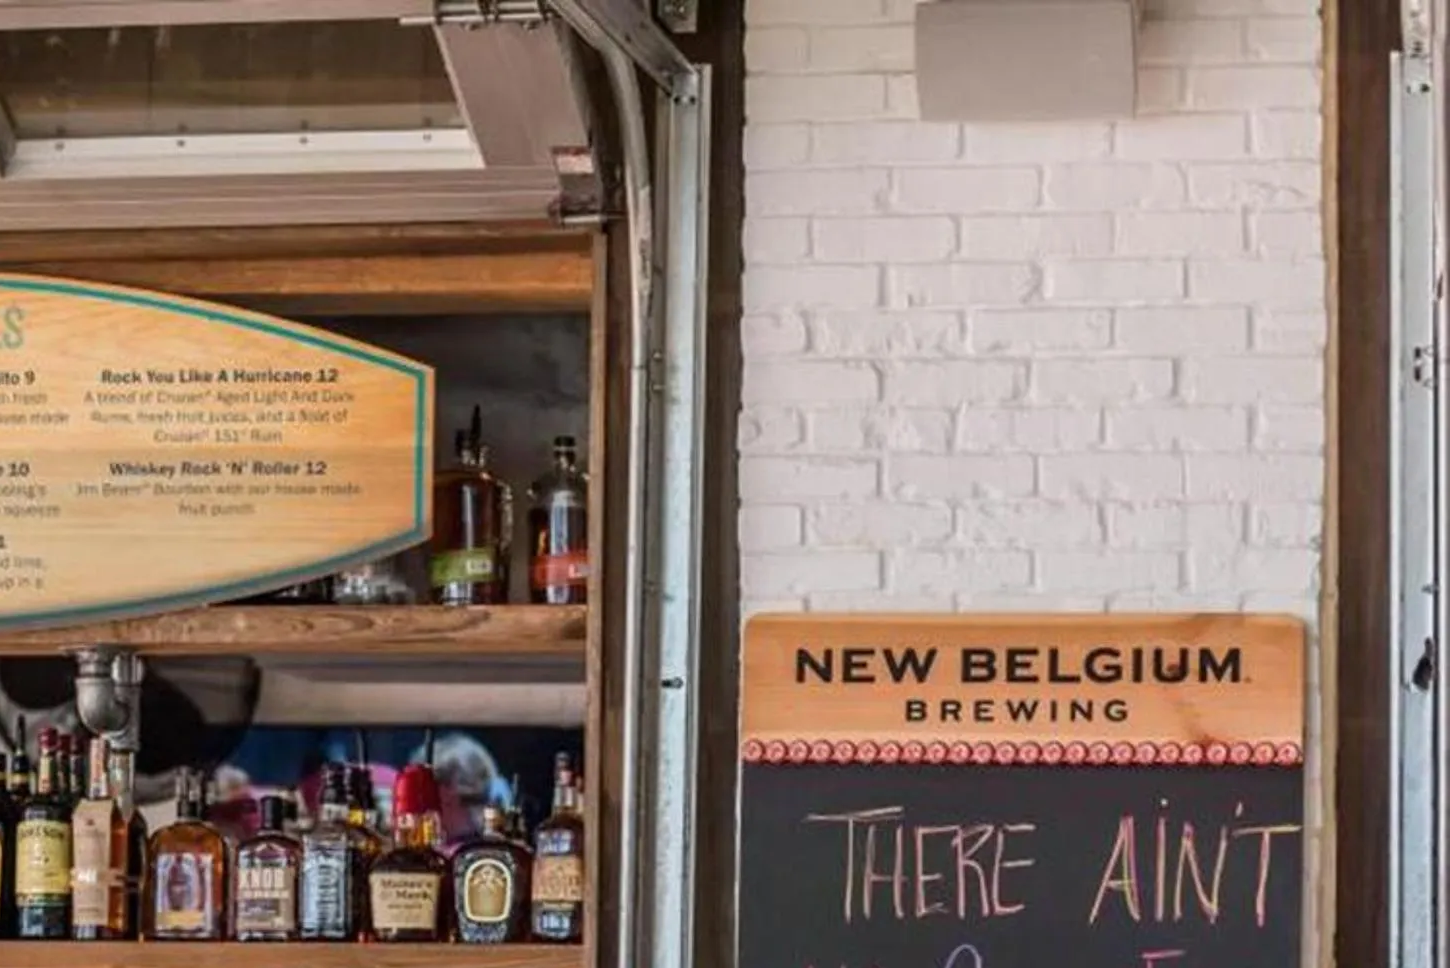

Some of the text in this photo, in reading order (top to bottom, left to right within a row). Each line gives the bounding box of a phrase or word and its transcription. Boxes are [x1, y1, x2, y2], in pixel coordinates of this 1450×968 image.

[26, 372, 35, 387] 9
[102, 369, 338, 384] Rock You Like A Hurricane 12
[9, 464, 29, 477] 10
[110, 462, 175, 477] Whiskey
[182, 462, 220, 477] Rock
[253, 462, 300, 477] Roller
[307, 462, 327, 477] 12
[795, 647, 1242, 684] NEW BELGIUM
[905, 699, 1129, 723] BREWING
[802, 806, 1036, 920] THERE
